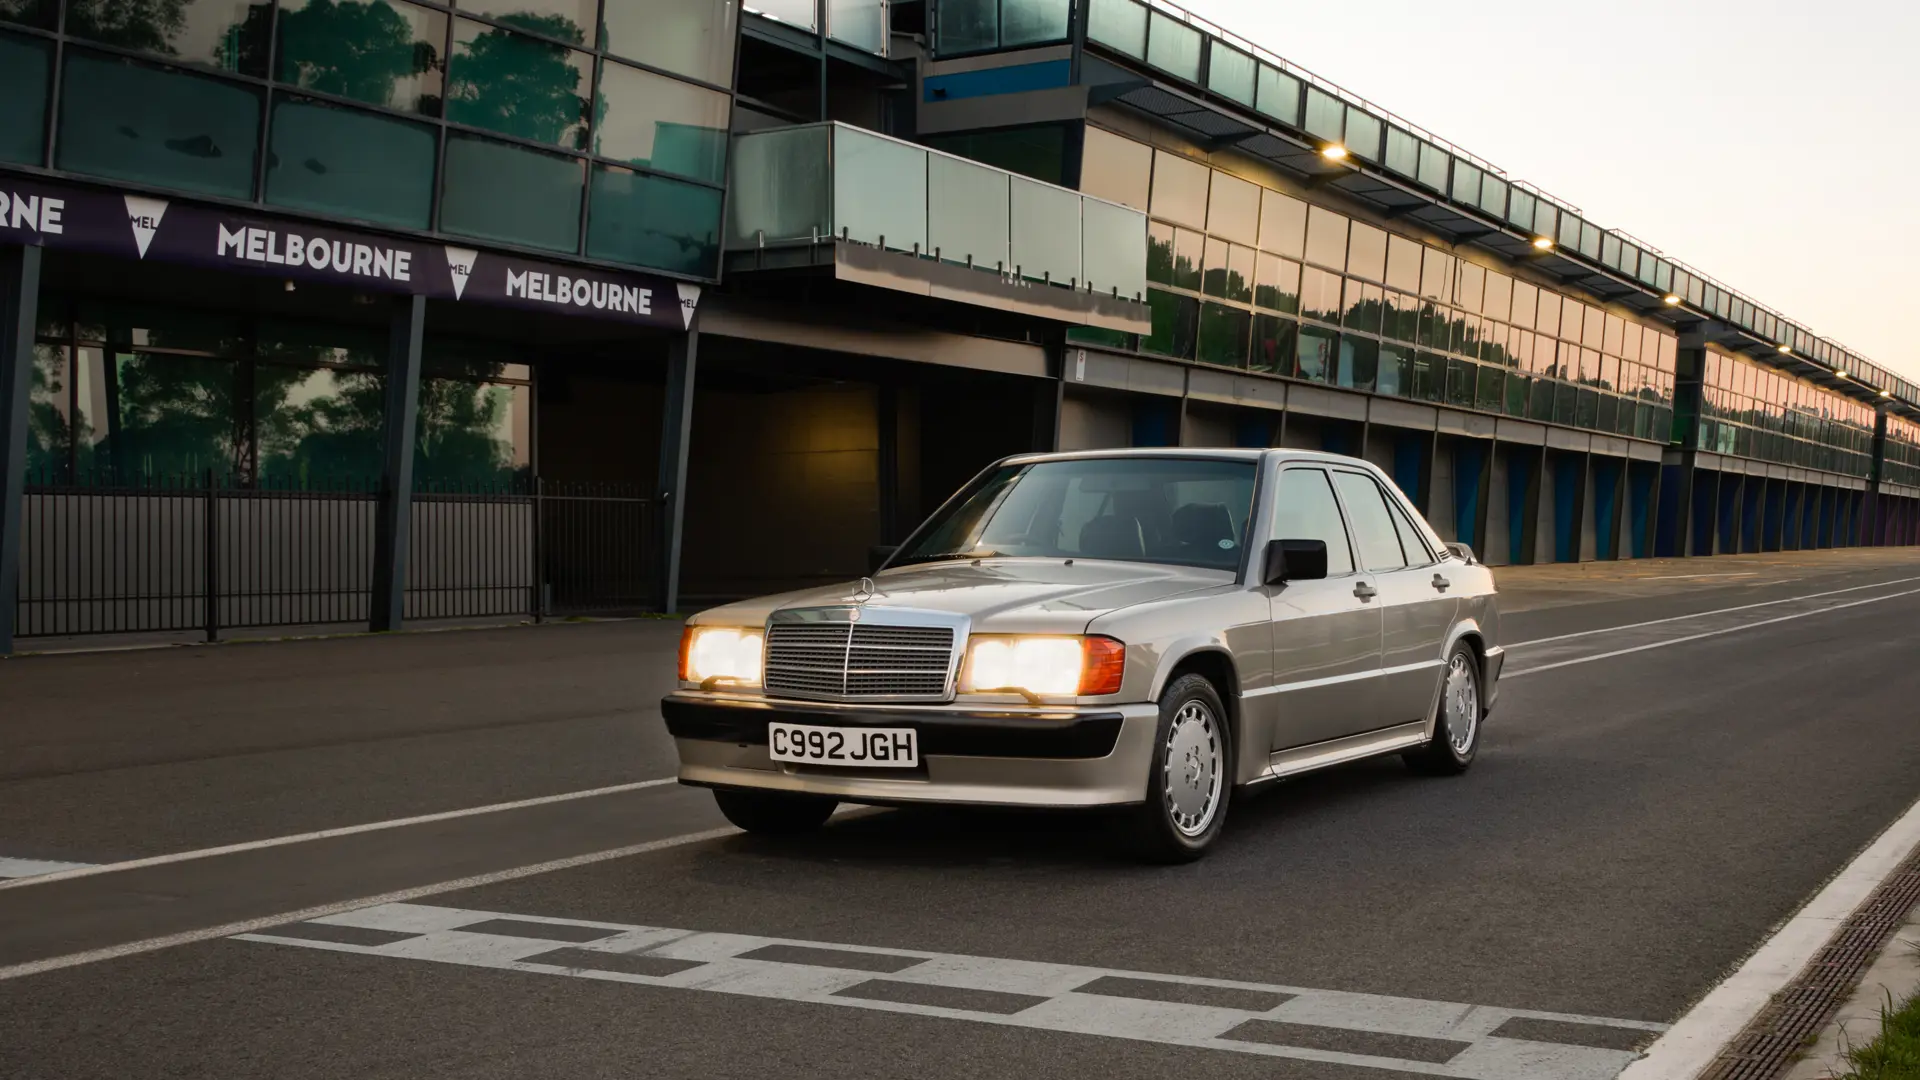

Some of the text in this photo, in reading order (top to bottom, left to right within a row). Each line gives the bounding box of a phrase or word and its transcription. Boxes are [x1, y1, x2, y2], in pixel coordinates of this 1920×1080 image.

[130, 214, 158, 230] MEL
[217, 222, 412, 282] MELBOURNE
[449, 263, 471, 276] MEL
[505, 267, 653, 315] MELBOURNE
[680, 298, 696, 309] MEL
[773, 728, 913, 761] C992 JGH
